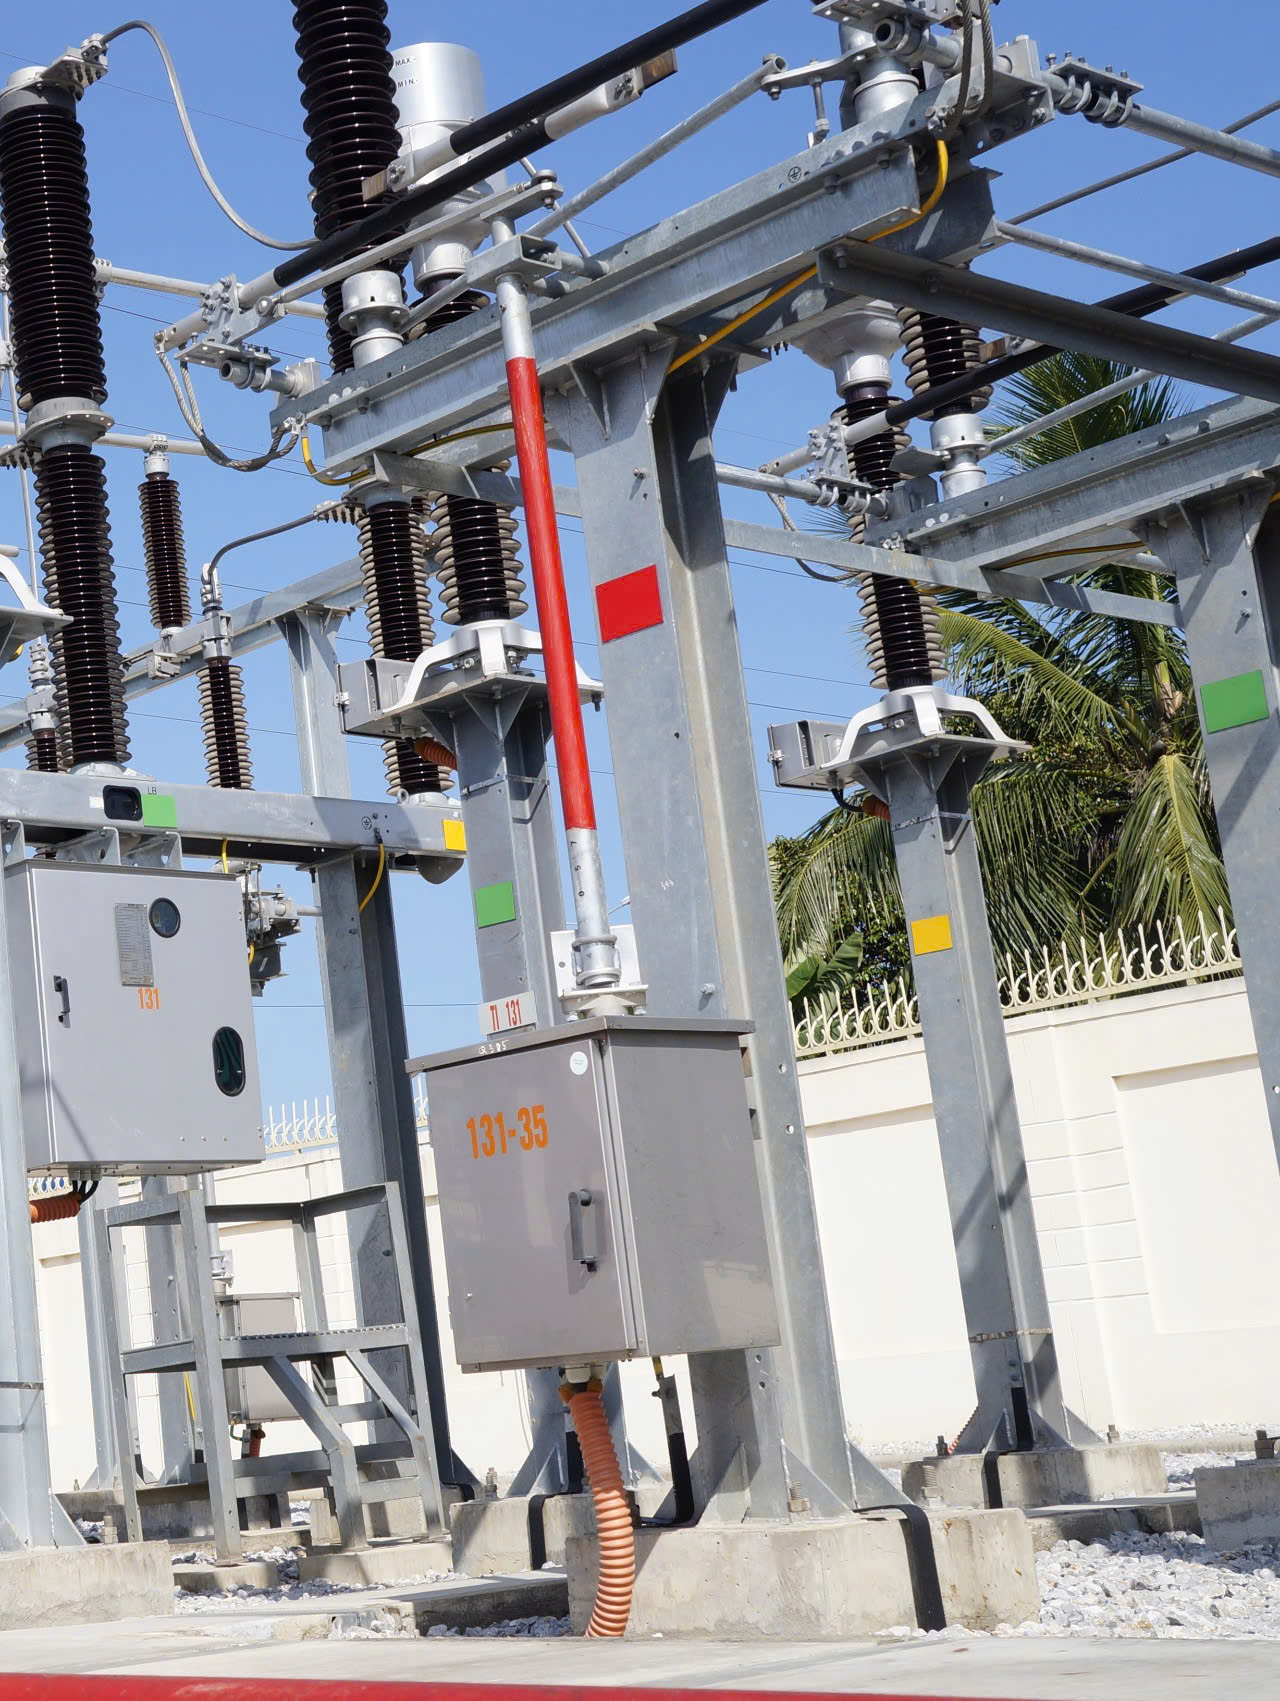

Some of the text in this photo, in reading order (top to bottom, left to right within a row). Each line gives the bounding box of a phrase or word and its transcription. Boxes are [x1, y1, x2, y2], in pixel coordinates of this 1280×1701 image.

[147, 785, 158, 796] LB
[138, 987, 160, 1009] 131
[505, 999, 522, 1027] 131
[466, 1104, 549, 1160] 131-35
